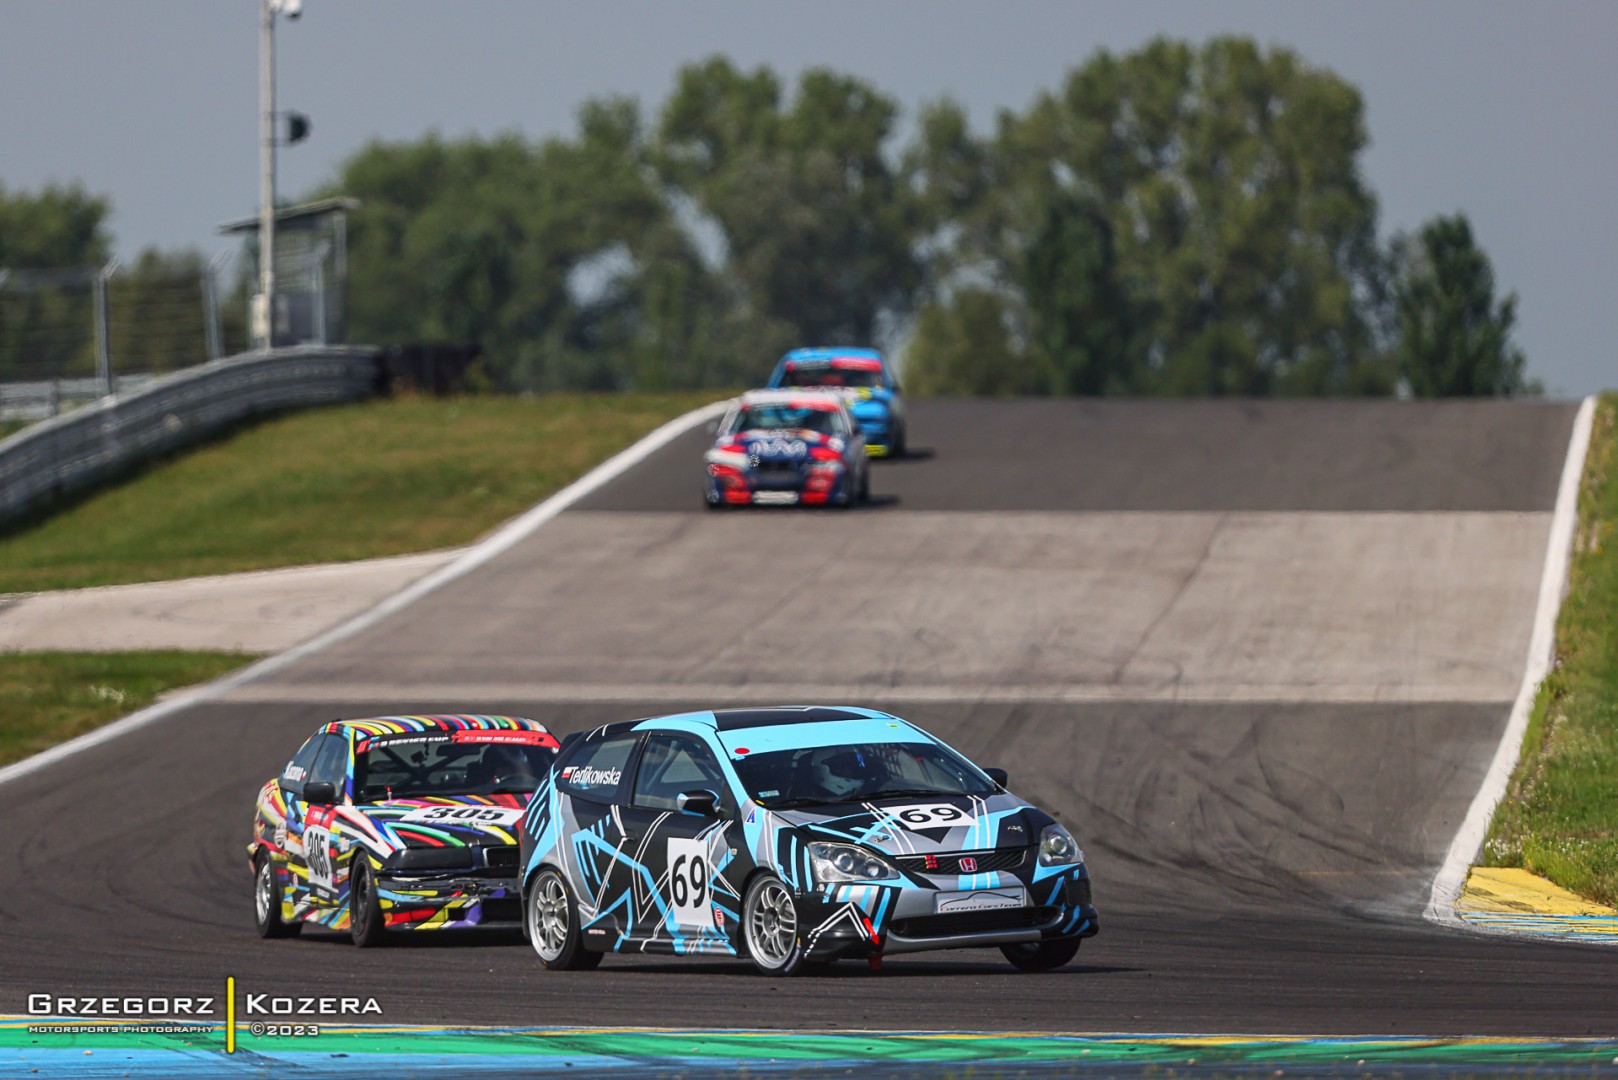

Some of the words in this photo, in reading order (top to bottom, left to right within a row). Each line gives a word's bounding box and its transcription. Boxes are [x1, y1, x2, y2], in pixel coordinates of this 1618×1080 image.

[424, 807, 510, 821] 305
[899, 807, 963, 823] 69
[308, 830, 329, 880] 305
[671, 854, 706, 909] 69
